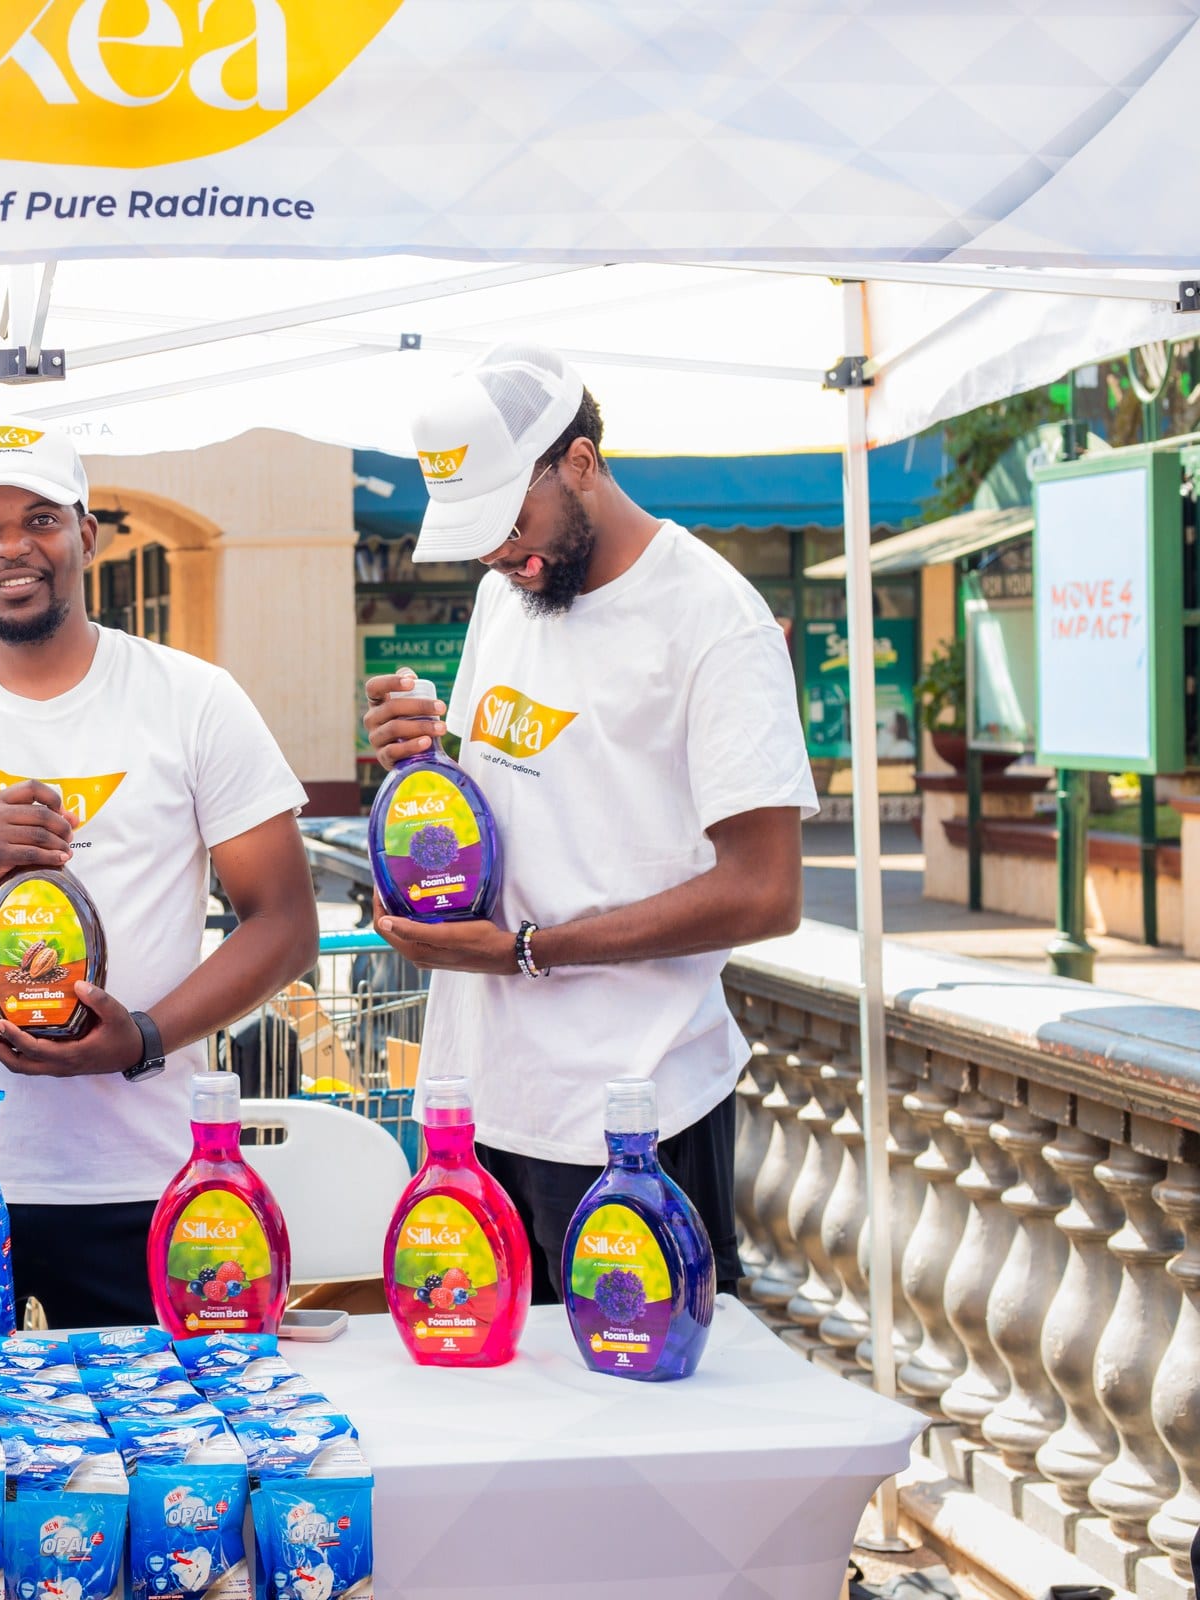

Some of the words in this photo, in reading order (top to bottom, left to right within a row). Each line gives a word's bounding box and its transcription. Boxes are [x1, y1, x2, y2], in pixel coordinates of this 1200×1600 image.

[25, 189, 118, 221] Pure
[128, 186, 316, 222] Radiance
[480, 694, 543, 751] Silkéa
[512, 764, 541, 778] adiance
[394, 797, 446, 818] Silkéa
[70, 841, 92, 849] ance
[421, 878, 445, 888] Foam
[445, 874, 466, 884] Bath
[436, 895, 449, 905] 2L
[3, 907, 55, 926] Silkéa
[19, 991, 43, 1000] Foam
[44, 990, 64, 999] Bath
[32, 1009, 45, 1019] 2L
[182, 1221, 237, 1239] Silkéa
[406, 1227, 461, 1245] Silkéa
[583, 1236, 637, 1256] Silkéa
[200, 1310, 225, 1318] Foam
[226, 1309, 248, 1318] Bath
[428, 1318, 453, 1326] Foam
[454, 1317, 476, 1326] Bath
[443, 1337, 456, 1347] 2L
[603, 1331, 628, 1341] Foam
[628, 1332, 650, 1342] Bath
[617, 1352, 631, 1363] 2L
[167, 1491, 183, 1505] NEW
[167, 1505, 219, 1526] OPAL
[44, 1520, 59, 1533] NEW
[291, 1521, 340, 1543] OPAL
[42, 1536, 92, 1555] OPAL
